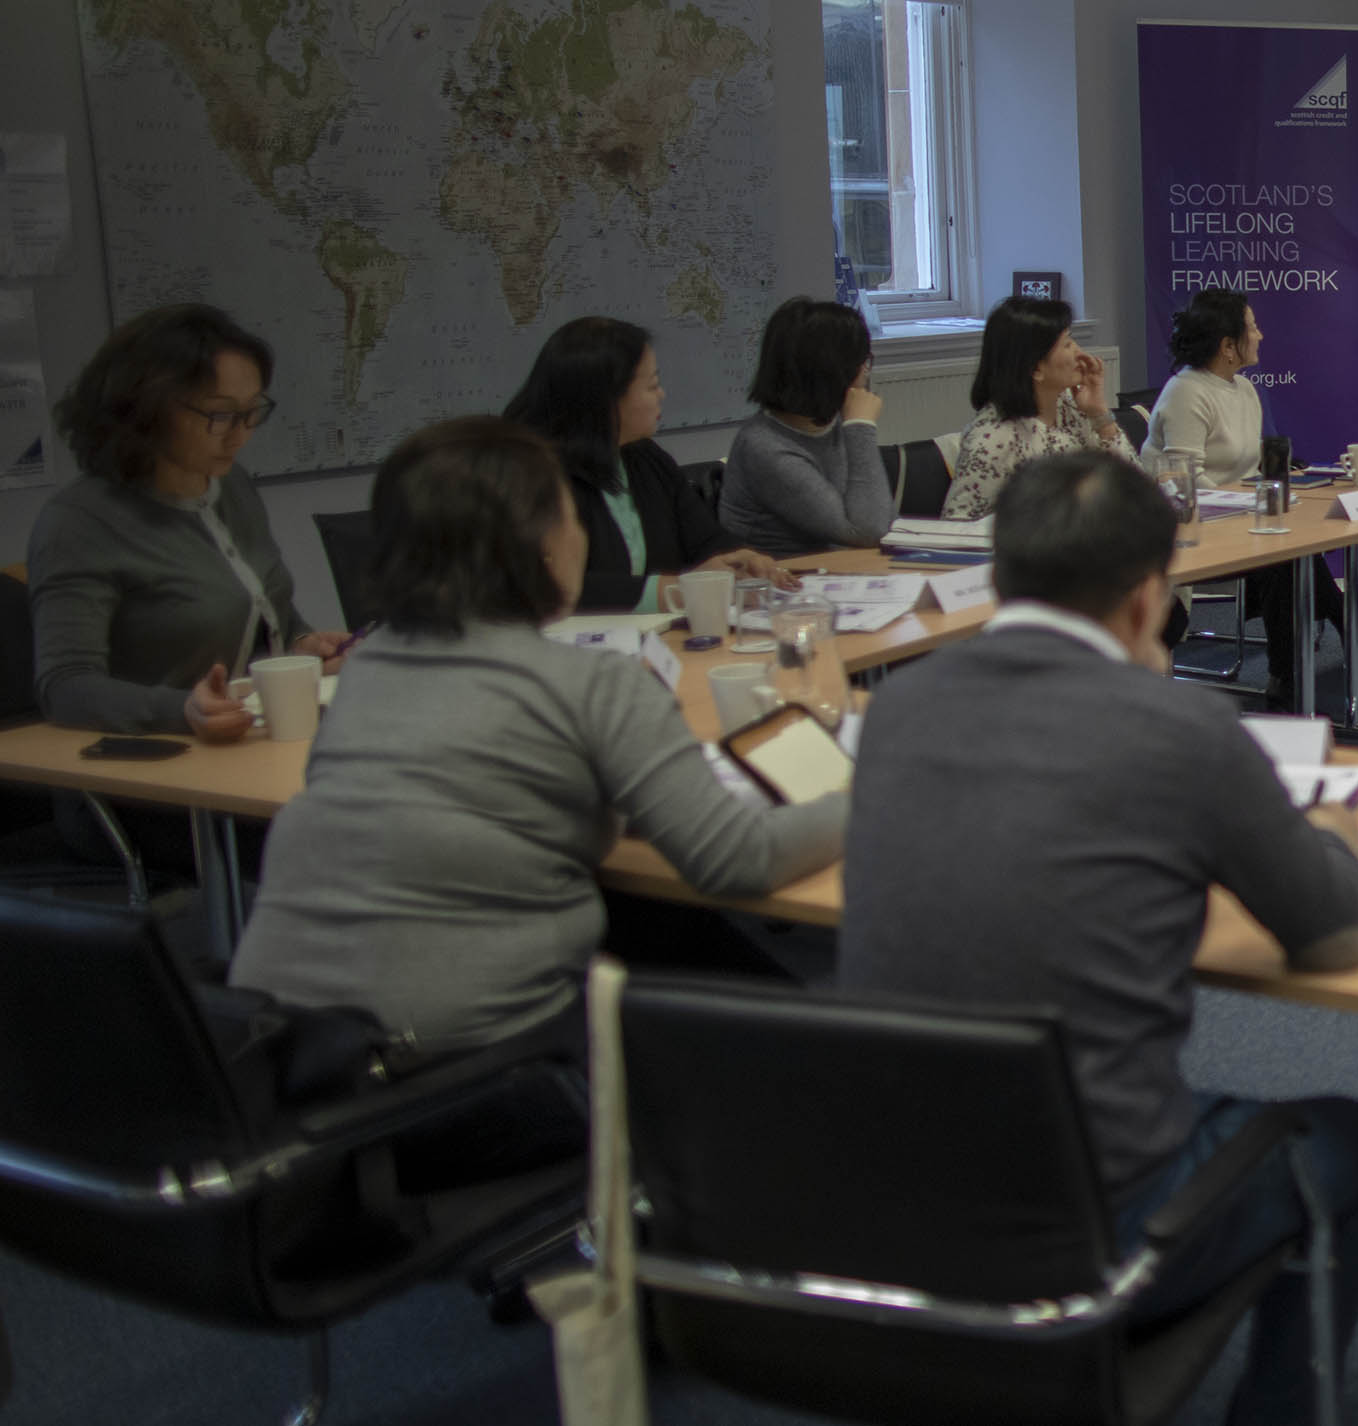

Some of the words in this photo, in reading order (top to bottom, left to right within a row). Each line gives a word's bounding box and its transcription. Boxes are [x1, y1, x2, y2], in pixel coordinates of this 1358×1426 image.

[1308, 91, 1348, 109] scqf
[1169, 183, 1334, 207] SCOTLAND'S
[1170, 212, 1295, 235] LIFELONG
[1171, 240, 1300, 262] LEARNING
[1172, 269, 1339, 291] FRAMEWORK
